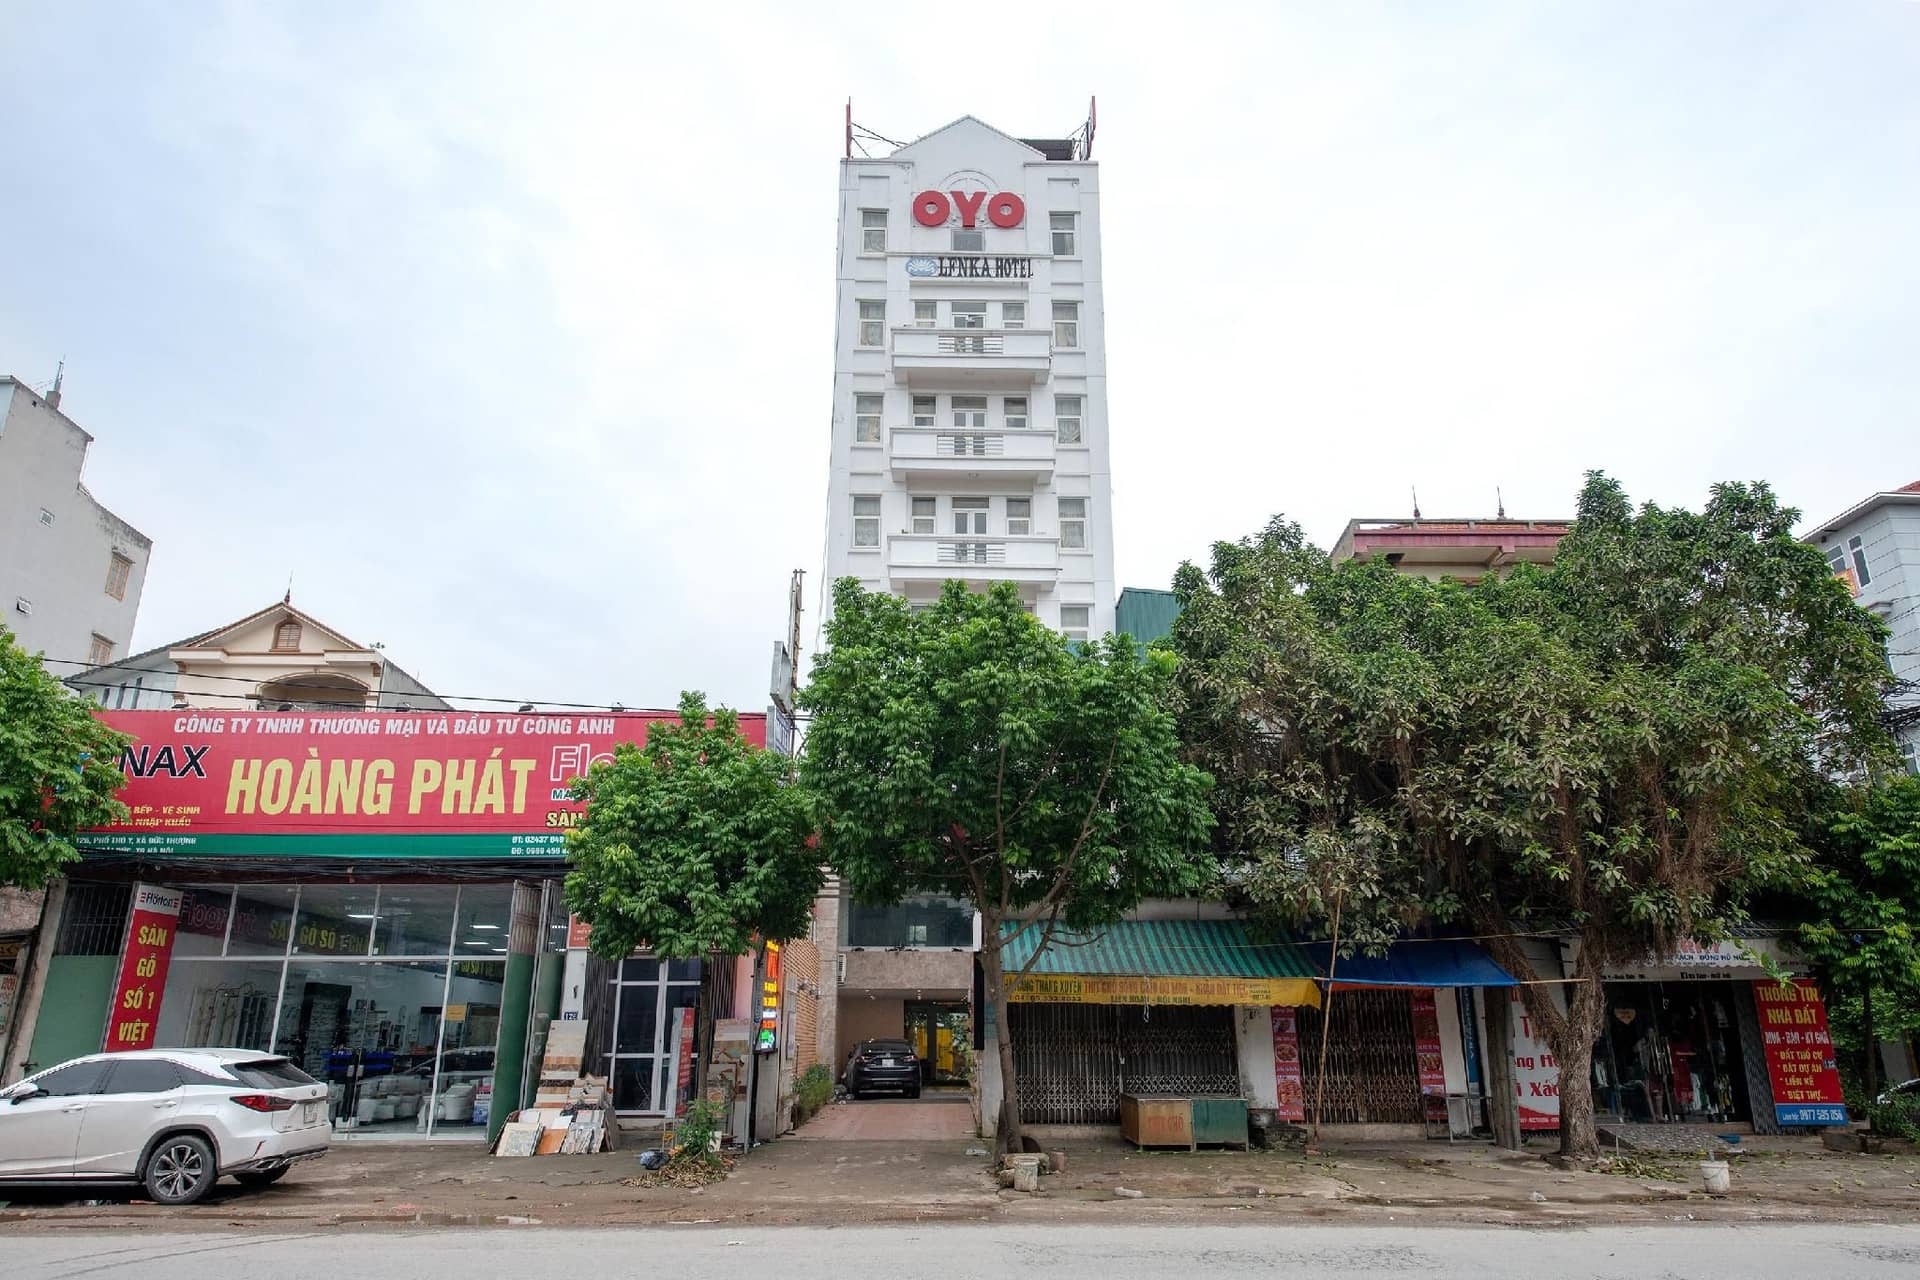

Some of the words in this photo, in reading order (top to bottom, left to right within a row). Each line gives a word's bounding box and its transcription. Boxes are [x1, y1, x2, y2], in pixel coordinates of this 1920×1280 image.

[913, 190, 1025, 229] OYO
[996, 257, 1034, 279] HOTEL
[174, 714, 225, 733] CÔNG
[230, 717, 252, 733] TY
[256, 717, 304, 734] TNHH
[309, 717, 381, 734] THƯƠNG
[385, 718, 420, 737] MẠI
[426, 715, 448, 734] VÀ
[453, 713, 491, 734] ĐẦU
[497, 716, 520, 734] TƯ
[577, 718, 615, 734] ANH
[112, 744, 211, 778] NAX
[225, 746, 395, 815] HOÀNG
[408, 747, 537, 815] PHÁT
[136, 952, 157, 978] GỖ
[123, 983, 146, 1009] SỐ
[148, 991, 155, 1010] 1
[1800, 987, 1819, 1002] TIN
[1766, 1006, 1793, 1024] NHÀ
[119, 1018, 151, 1046] VIỆT
